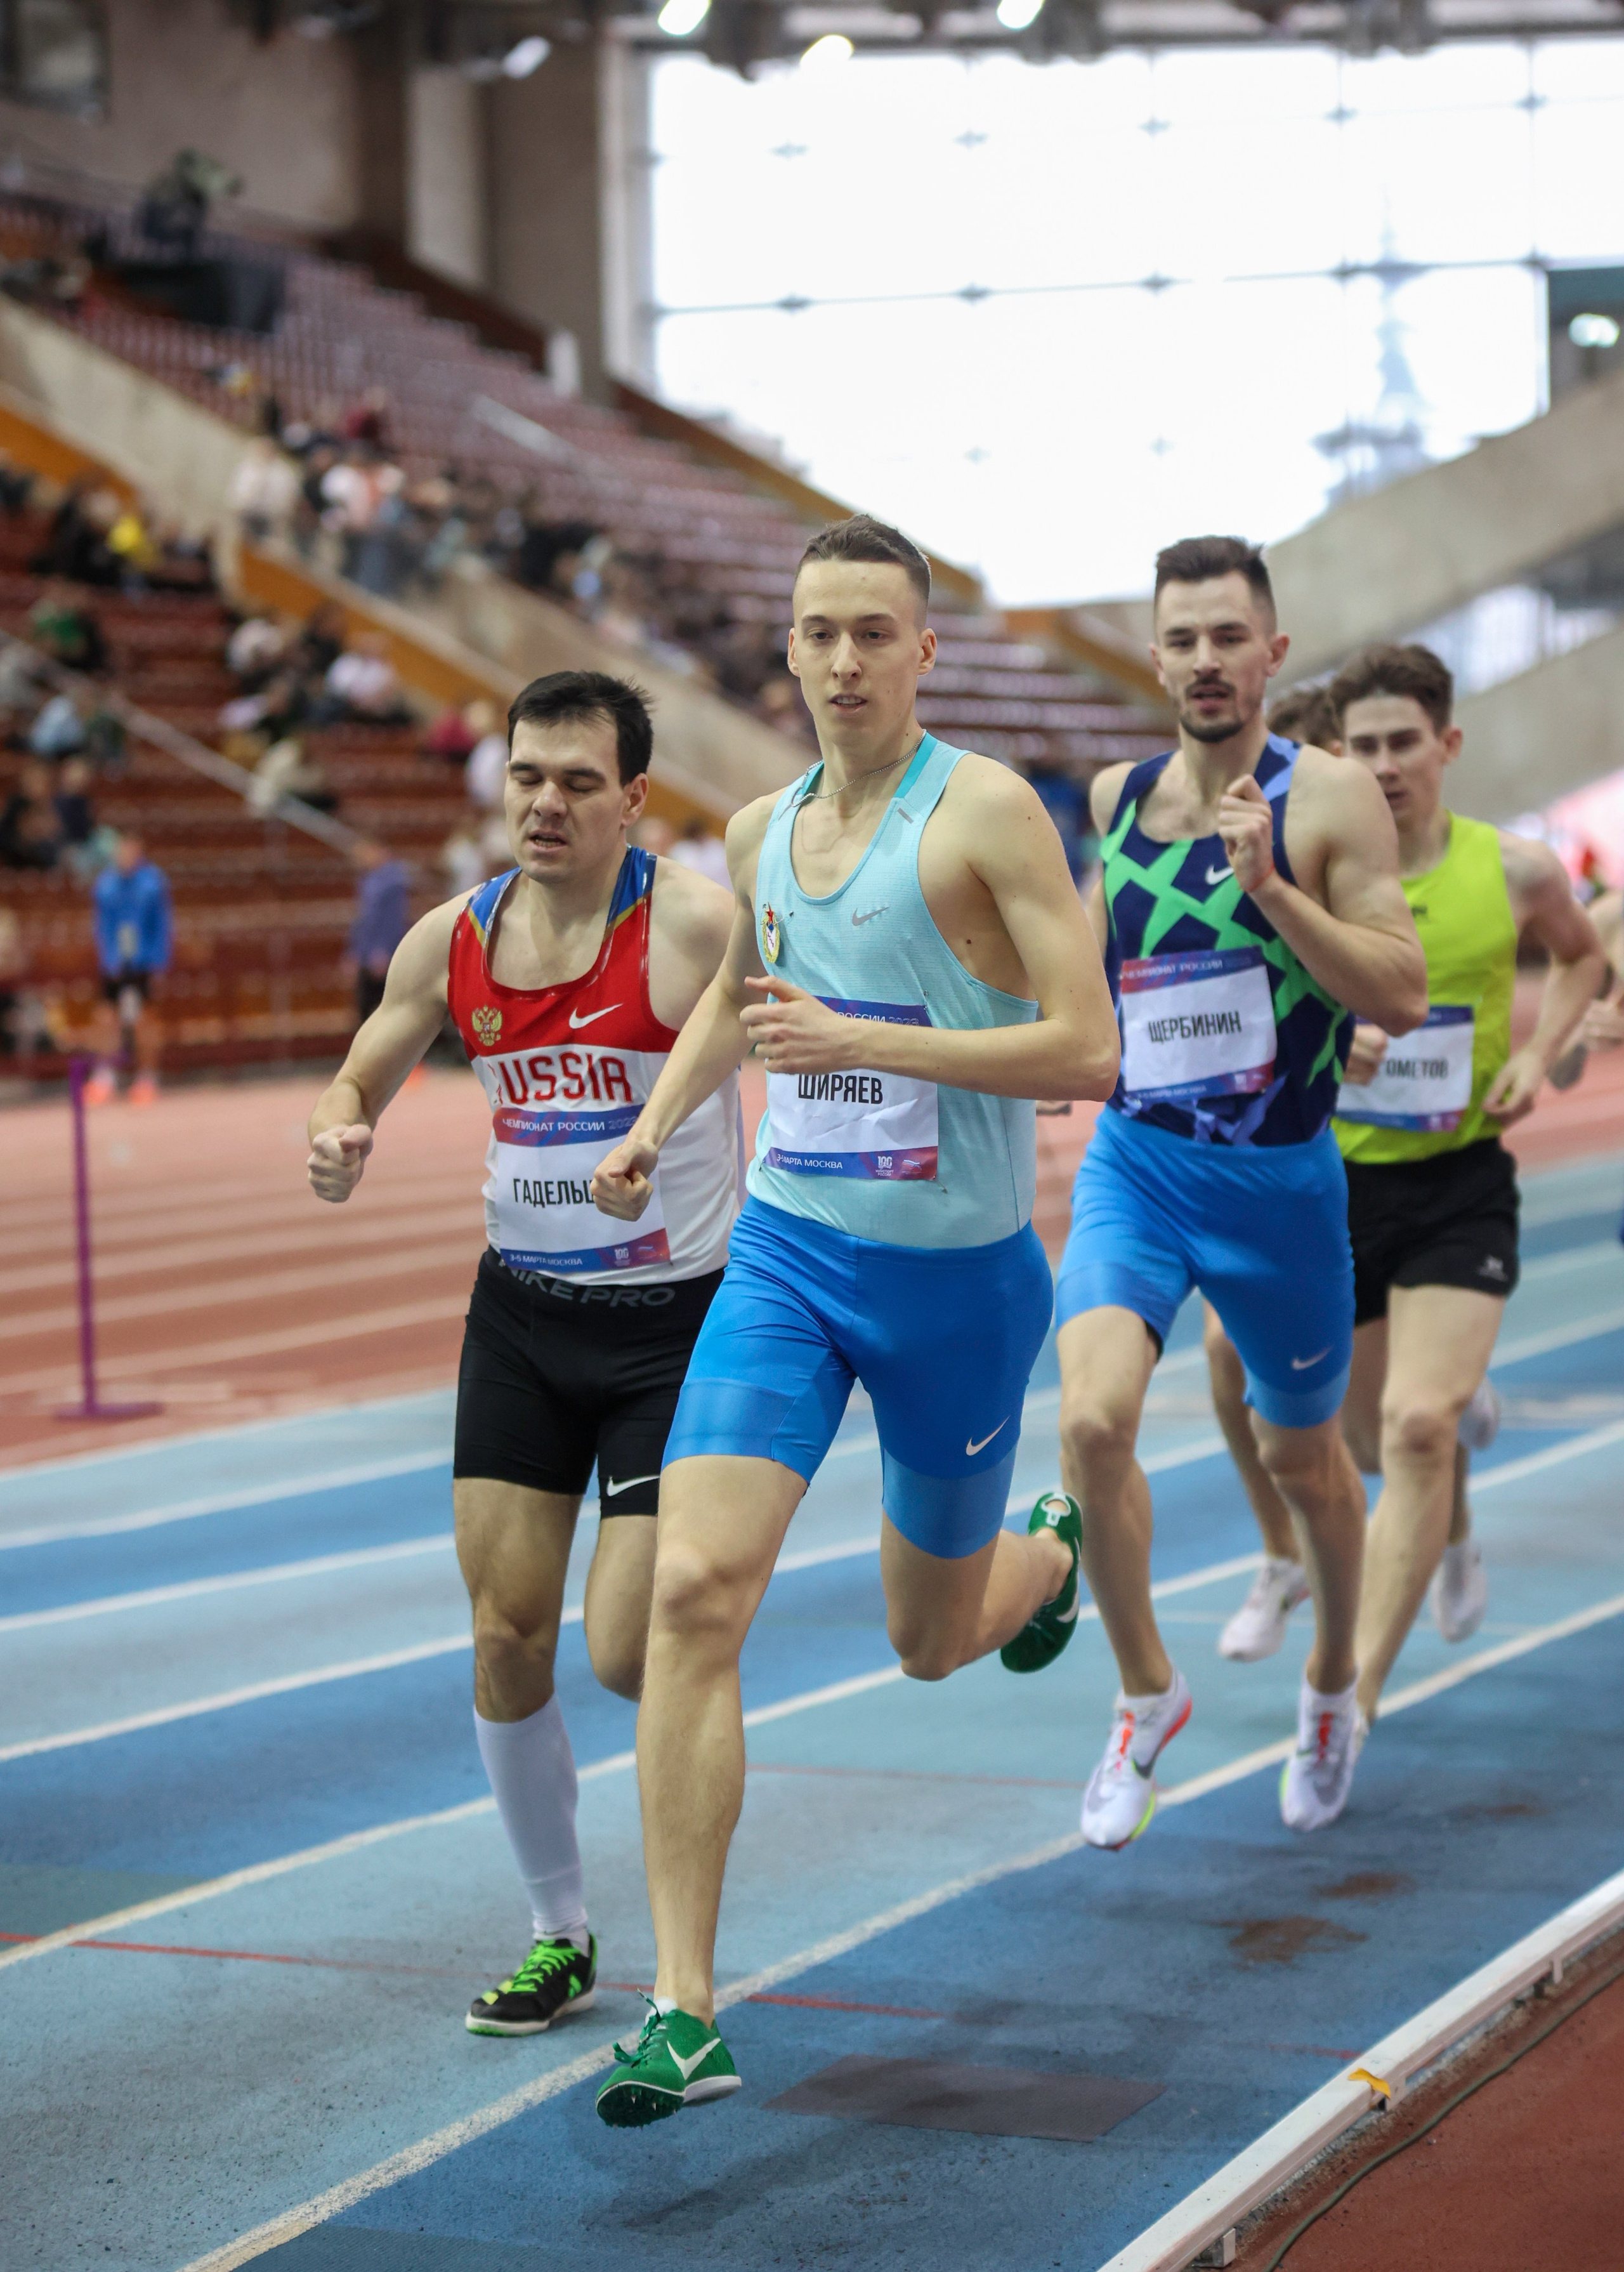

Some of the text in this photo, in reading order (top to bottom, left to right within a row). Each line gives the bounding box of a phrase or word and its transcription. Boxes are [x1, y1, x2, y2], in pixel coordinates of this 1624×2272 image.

[1148, 1010, 1242, 1044] ЩЕРБИНИН
[1385, 1056, 1449, 1079] ОМЕТОВ
[798, 1074, 883, 1104] ШИРЯЕВ
[502, 1118, 554, 1132] ЧЕМПИОНАТ
[558, 1122, 605, 1131] РОССИИ
[804, 1159, 842, 1169] МОСКВА
[523, 1256, 547, 1264] МАРТА
[547, 1257, 583, 1266] МОСКВА
[580, 1287, 676, 1308] PRO
